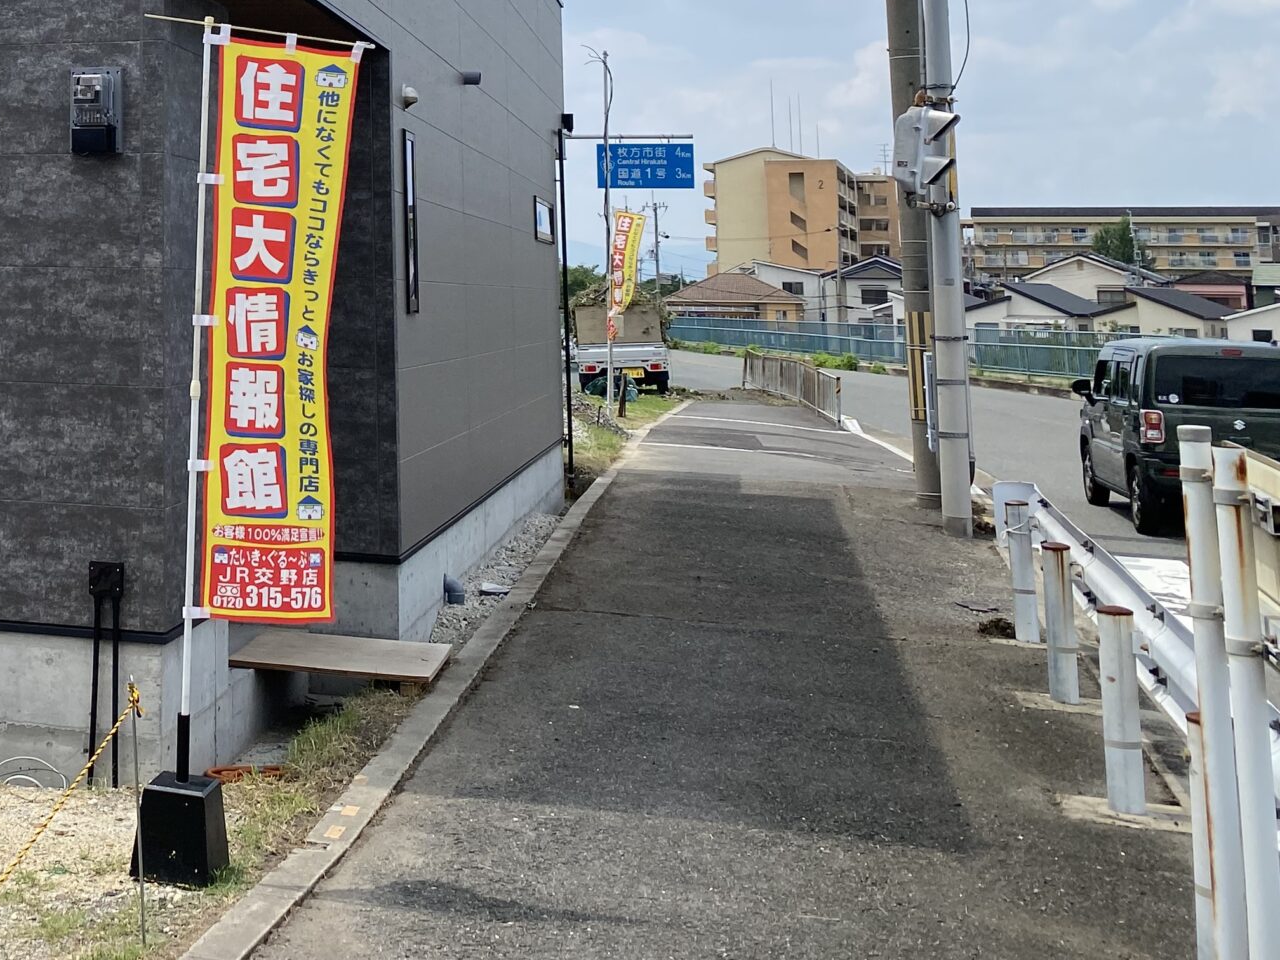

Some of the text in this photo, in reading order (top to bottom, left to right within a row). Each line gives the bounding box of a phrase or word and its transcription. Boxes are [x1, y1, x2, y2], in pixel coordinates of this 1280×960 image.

[302, 90, 340, 322] 他になくてもココならきっと
[617, 147, 666, 158] 枚方市街
[224, 61, 296, 511] 住宅大情報館
[297, 351, 320, 493] お家探しの専門店
[213, 585, 322, 609] 0120 315-576
